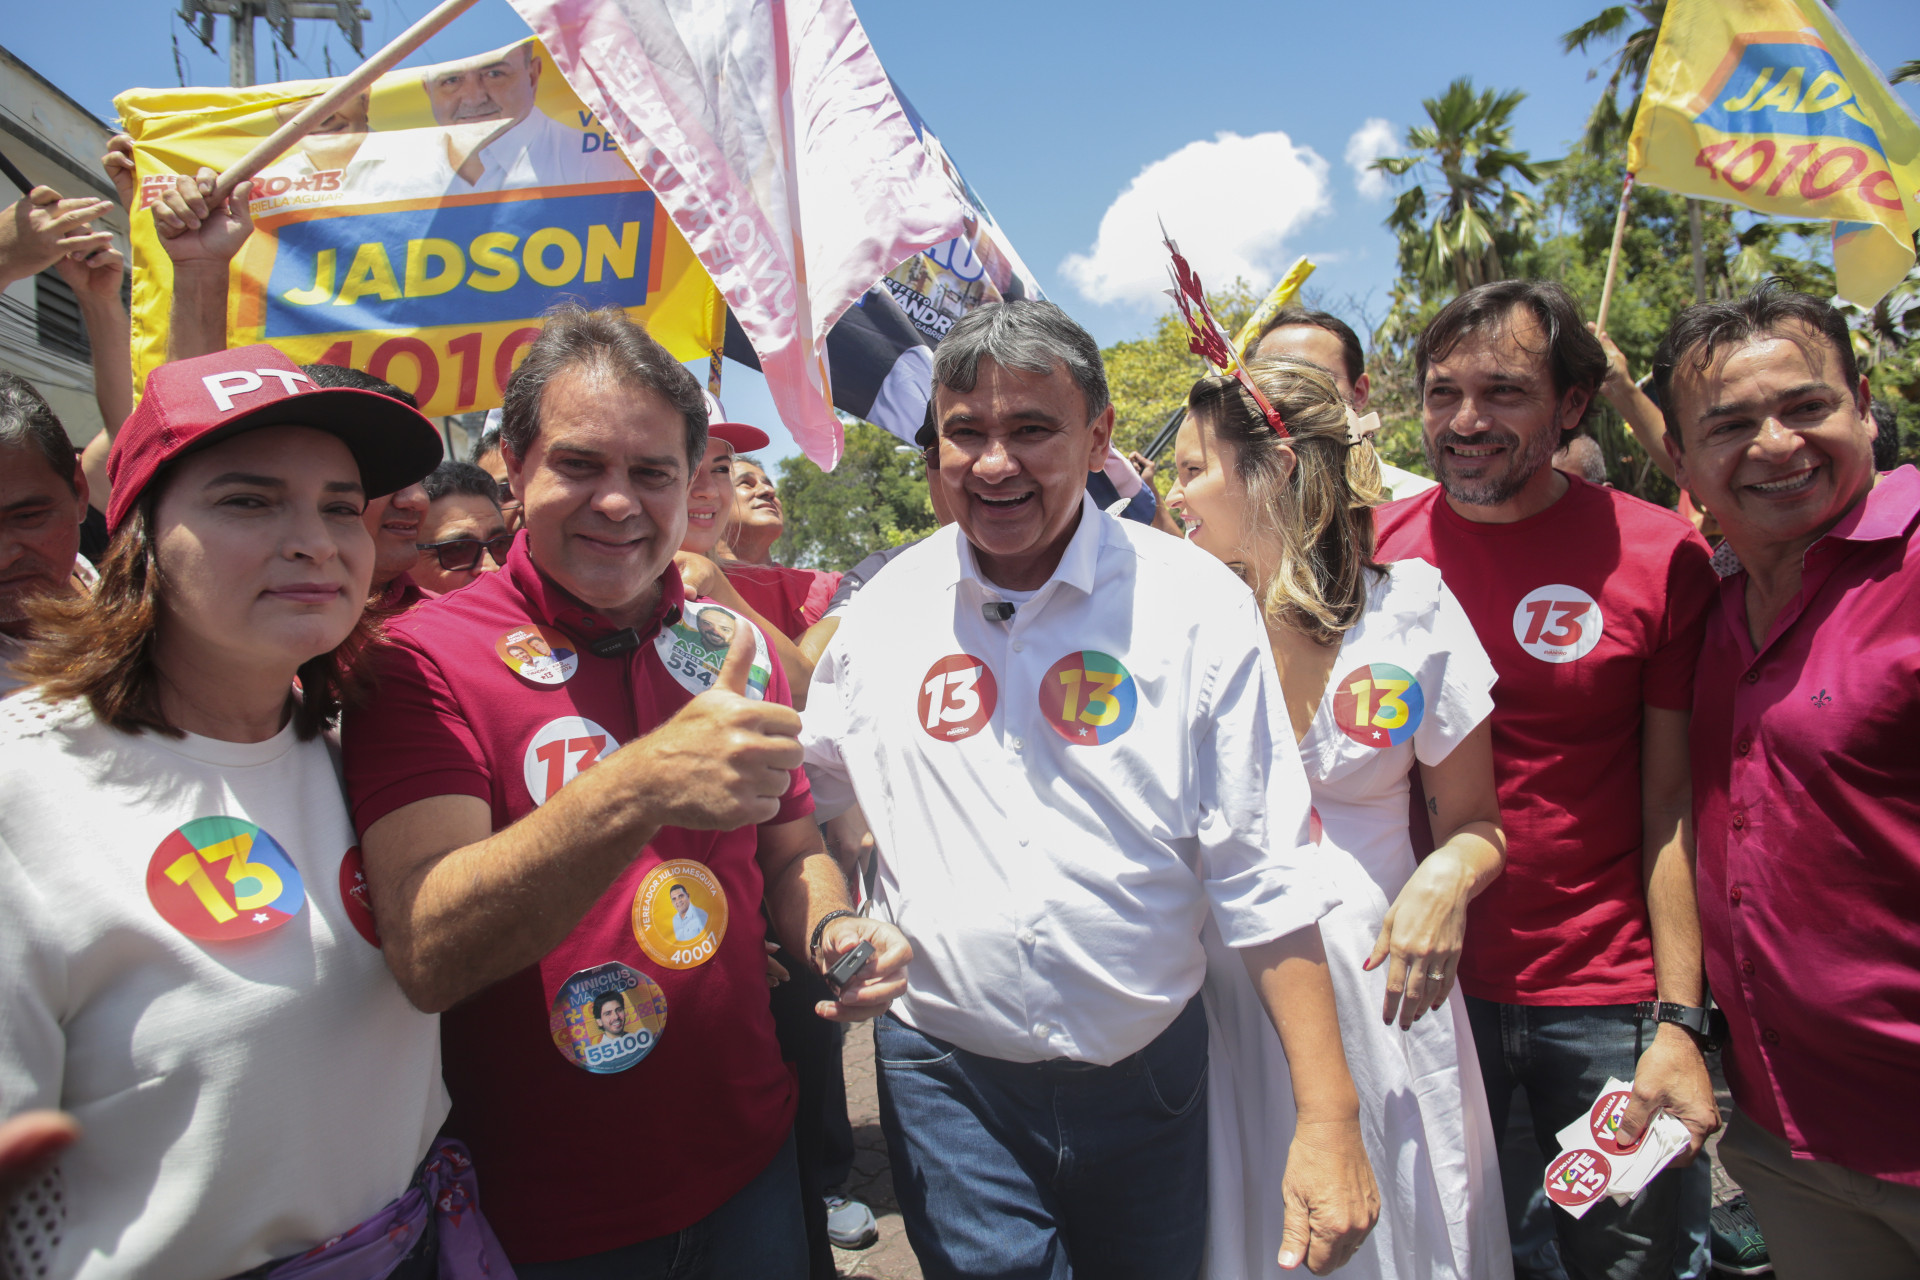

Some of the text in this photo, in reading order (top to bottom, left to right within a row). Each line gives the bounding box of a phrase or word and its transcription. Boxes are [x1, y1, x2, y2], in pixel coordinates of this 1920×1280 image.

[283, 221, 641, 306] JADSON
[883, 277, 931, 306] REFEITO
[914, 321, 945, 341] GABRIE
[202, 368, 309, 412] PT
[1523, 599, 1592, 646] 13
[925, 664, 983, 729] 13
[1059, 668, 1122, 727] 13
[1349, 678, 1410, 729] 13
[164, 832, 283, 924] 13
[642, 879, 661, 932] VEREADOR
[682, 866, 717, 897] MESQUITA
[670, 931, 717, 964] 40007
[570, 969, 630, 994] VINICIUS
[587, 1031, 650, 1063] 55100
[1551, 1152, 1596, 1191] VOTE
[1571, 1168, 1605, 1197] 13
